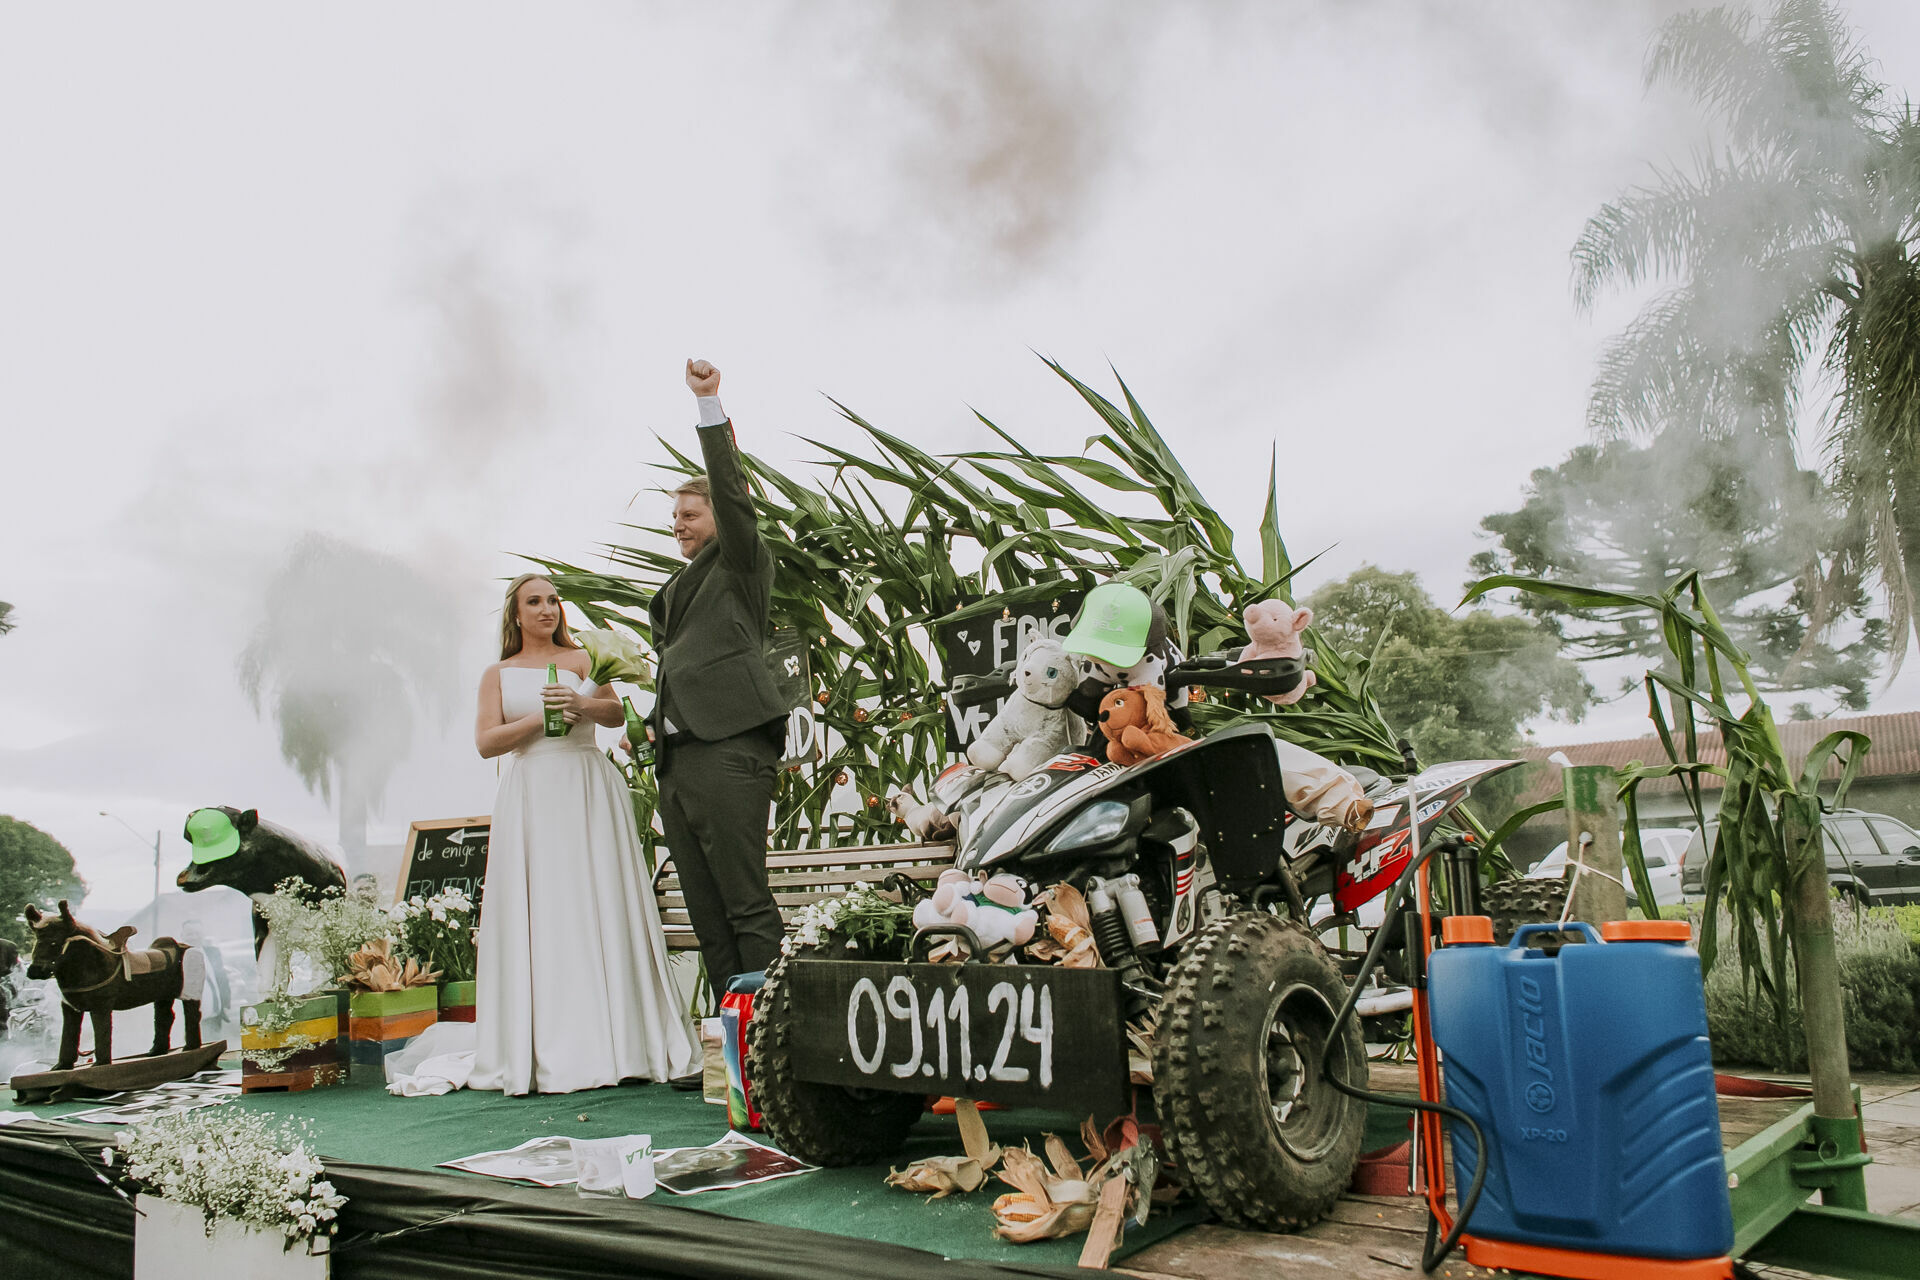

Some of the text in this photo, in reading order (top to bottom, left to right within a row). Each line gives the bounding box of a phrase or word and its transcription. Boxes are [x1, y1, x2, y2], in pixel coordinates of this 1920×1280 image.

[417, 838, 433, 860] de
[441, 844, 475, 867] enige
[1346, 827, 1411, 879] YFZ
[847, 975, 1053, 1088] 09.11.24
